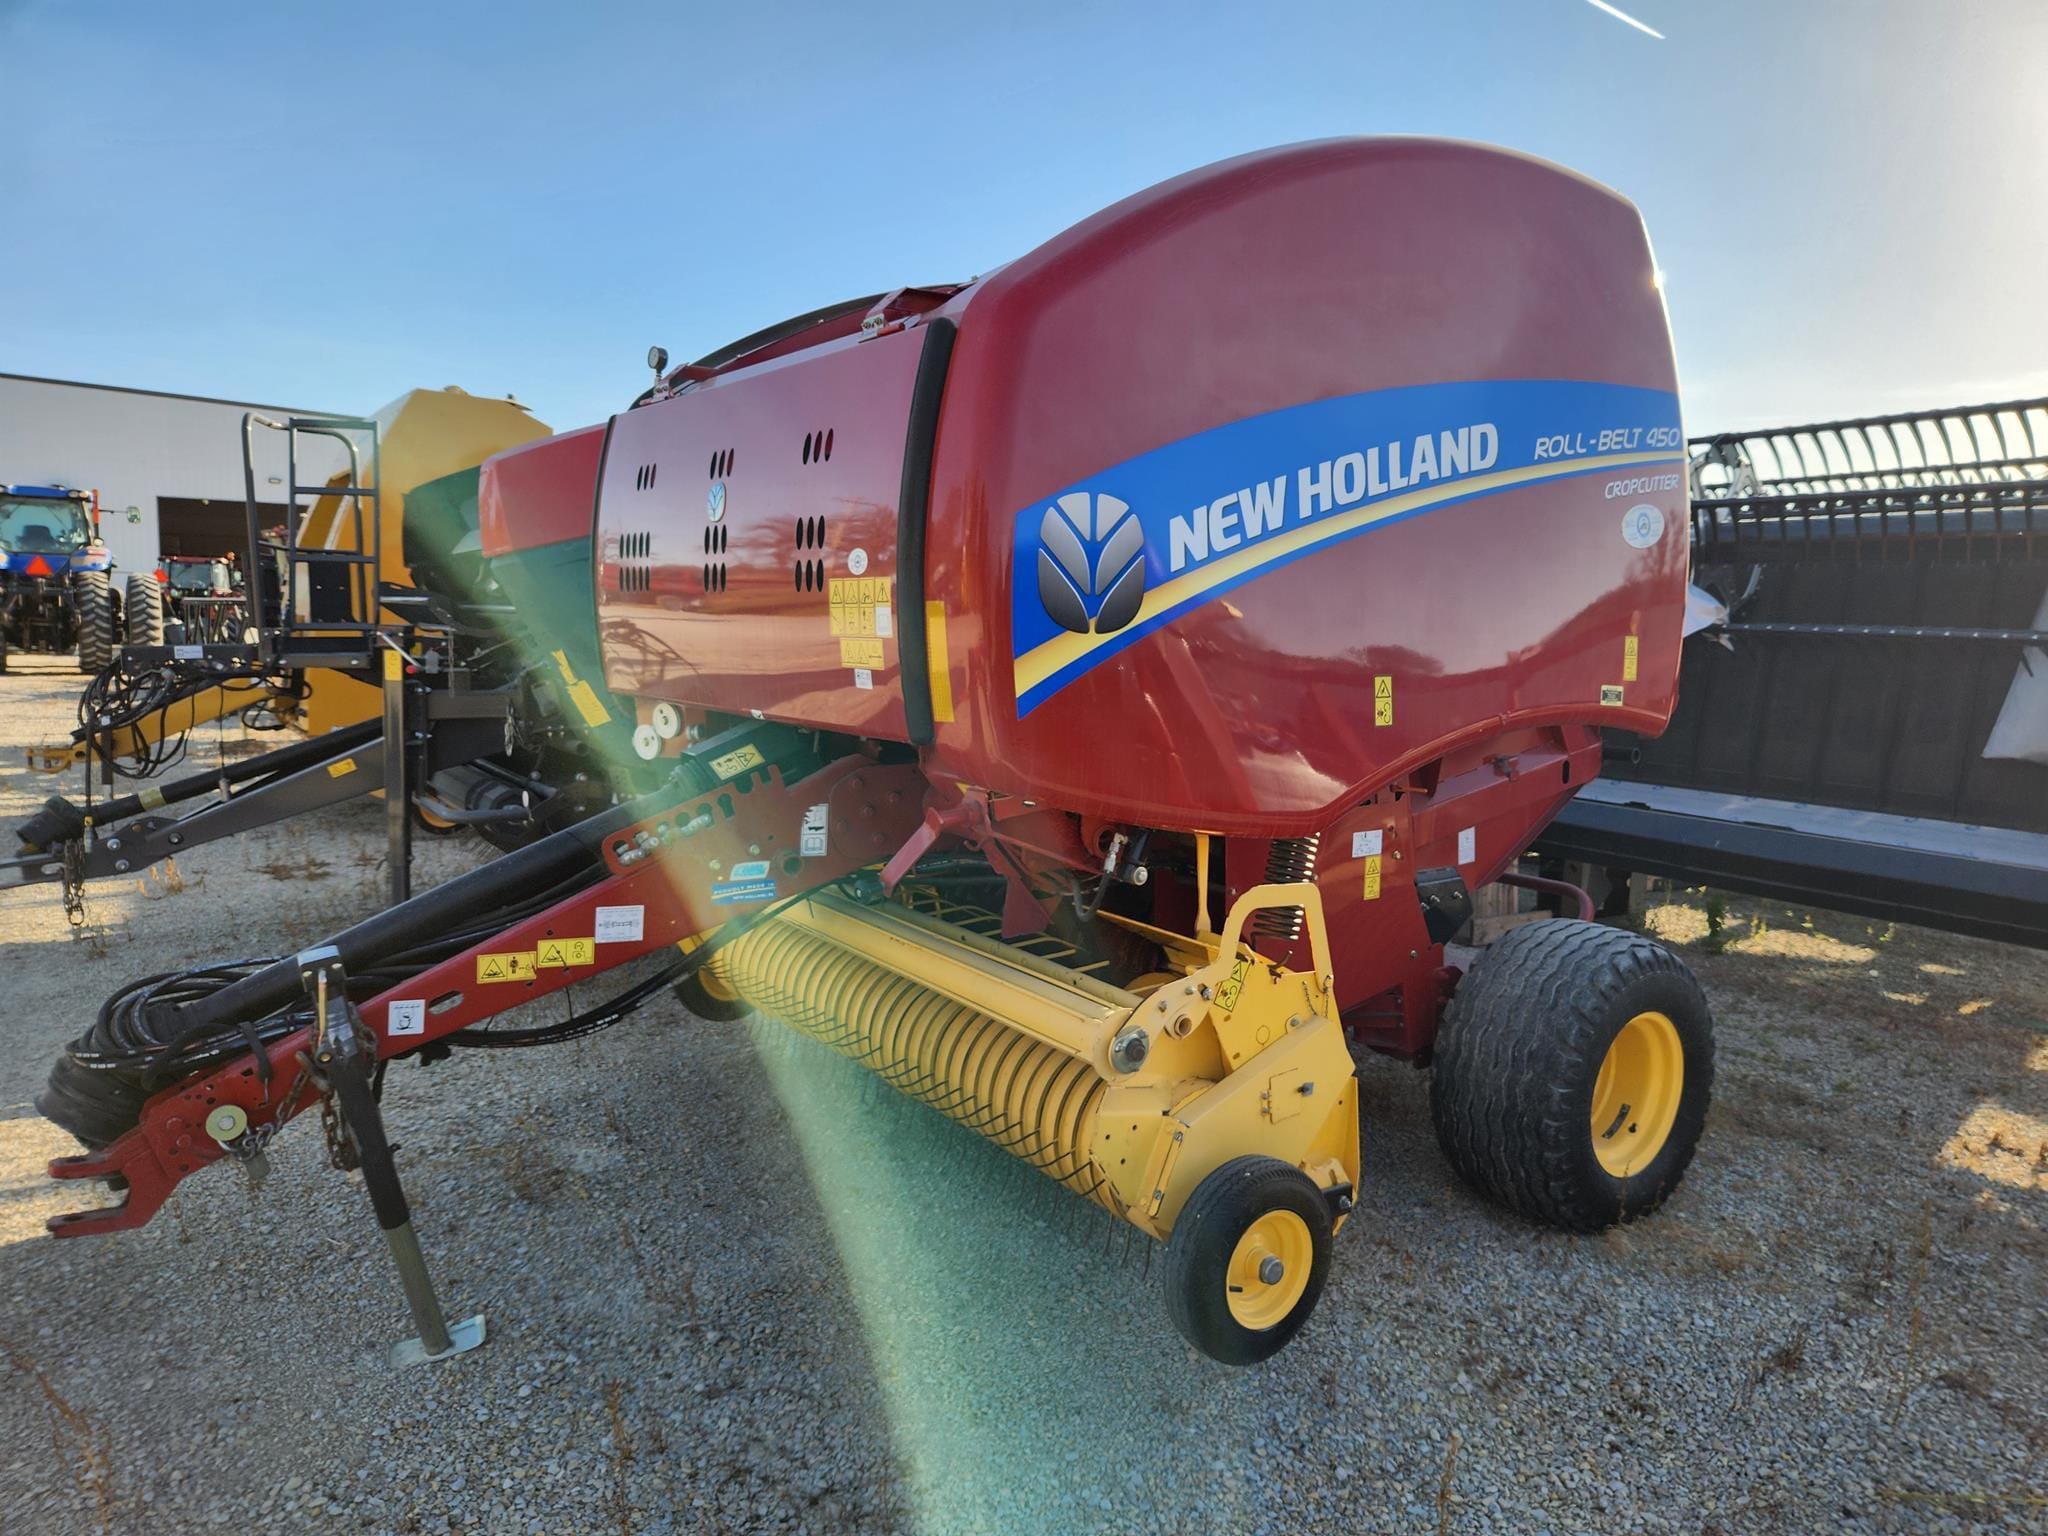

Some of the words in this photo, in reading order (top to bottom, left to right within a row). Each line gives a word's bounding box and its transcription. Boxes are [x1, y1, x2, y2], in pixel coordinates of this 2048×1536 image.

[1534, 428, 1642, 460] ROLL-BELT
[1646, 428, 1680, 448] 450
[1169, 475, 1287, 572] NEW
[1298, 423, 1498, 519] HOLLAND
[1605, 474, 1680, 499] CROPCUTTER
